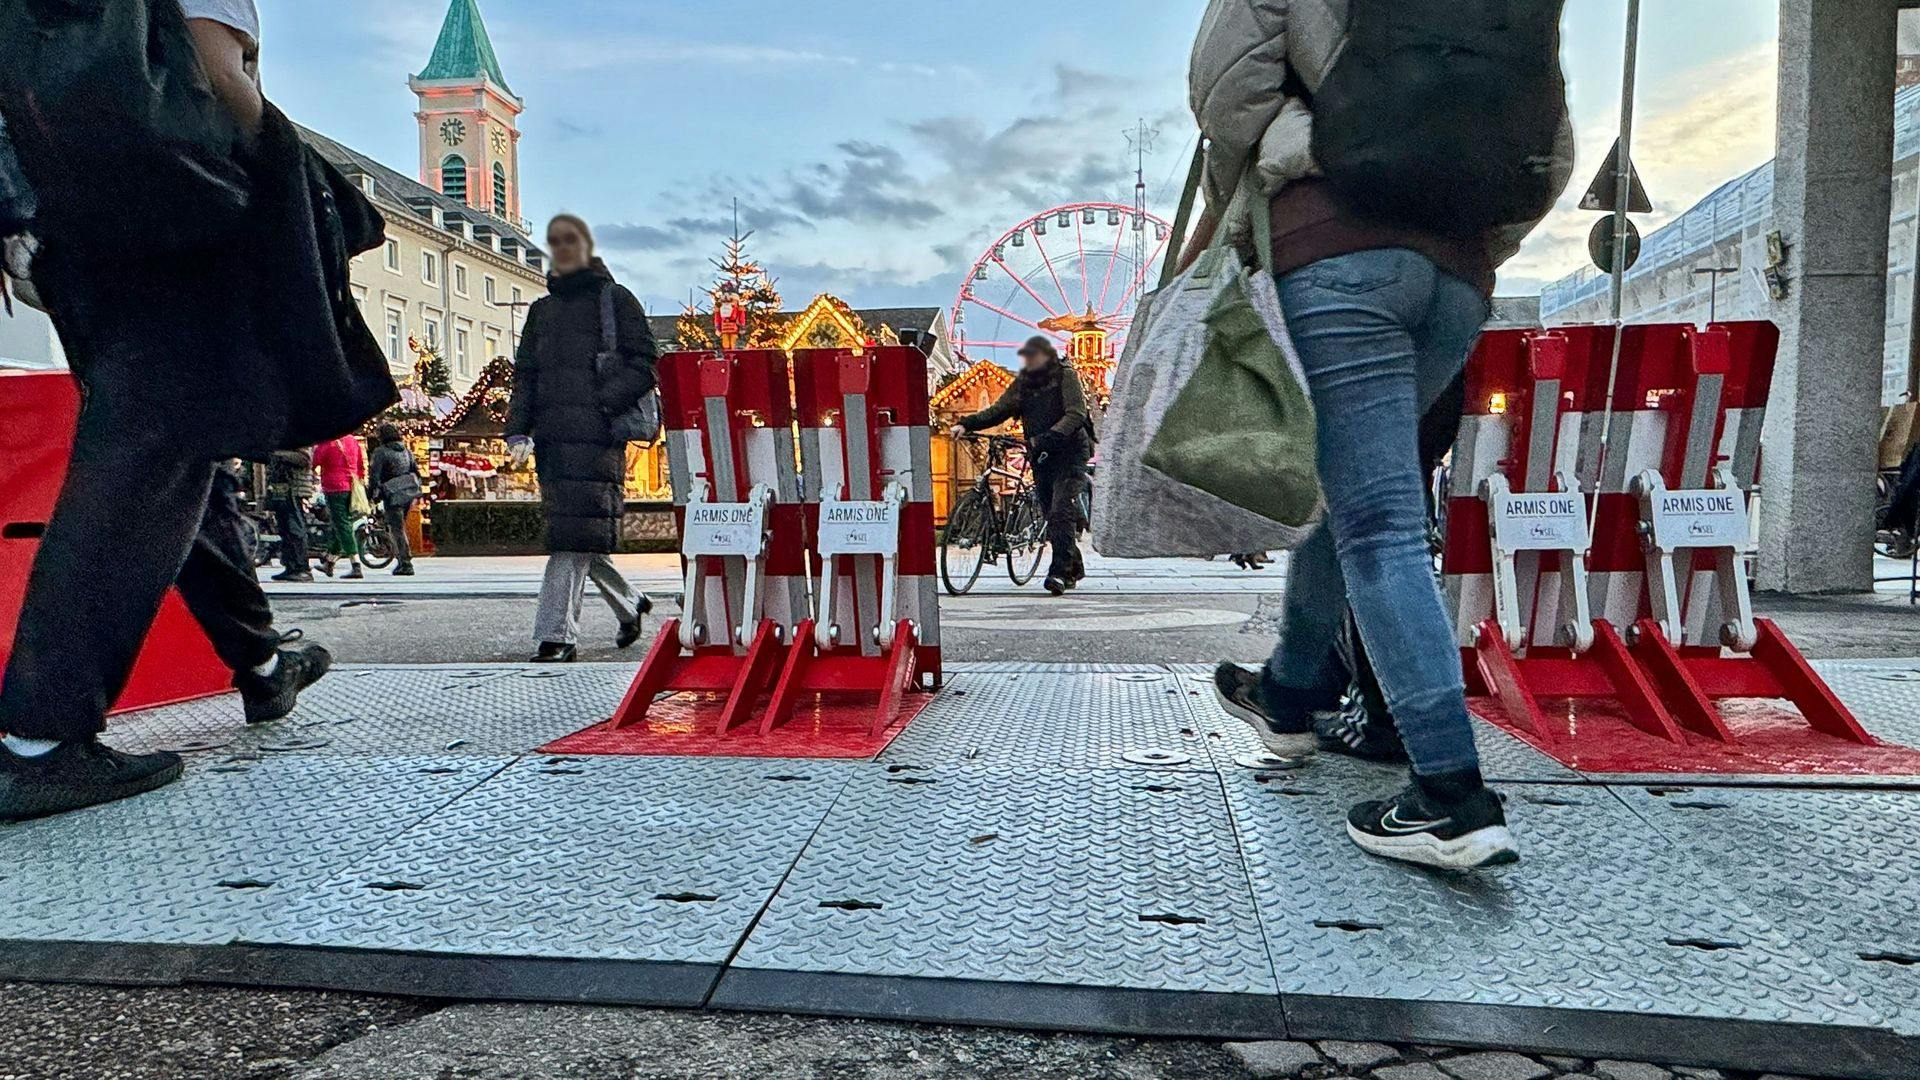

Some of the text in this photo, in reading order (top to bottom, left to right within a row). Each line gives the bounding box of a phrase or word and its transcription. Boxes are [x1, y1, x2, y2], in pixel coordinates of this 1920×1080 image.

[1506, 499, 1575, 515] ARMIS ONE
[1663, 496, 1734, 513] ARMIS ONE
[694, 509, 753, 523] ARMIS ONE
[828, 507, 889, 521] ARMIS ONE
